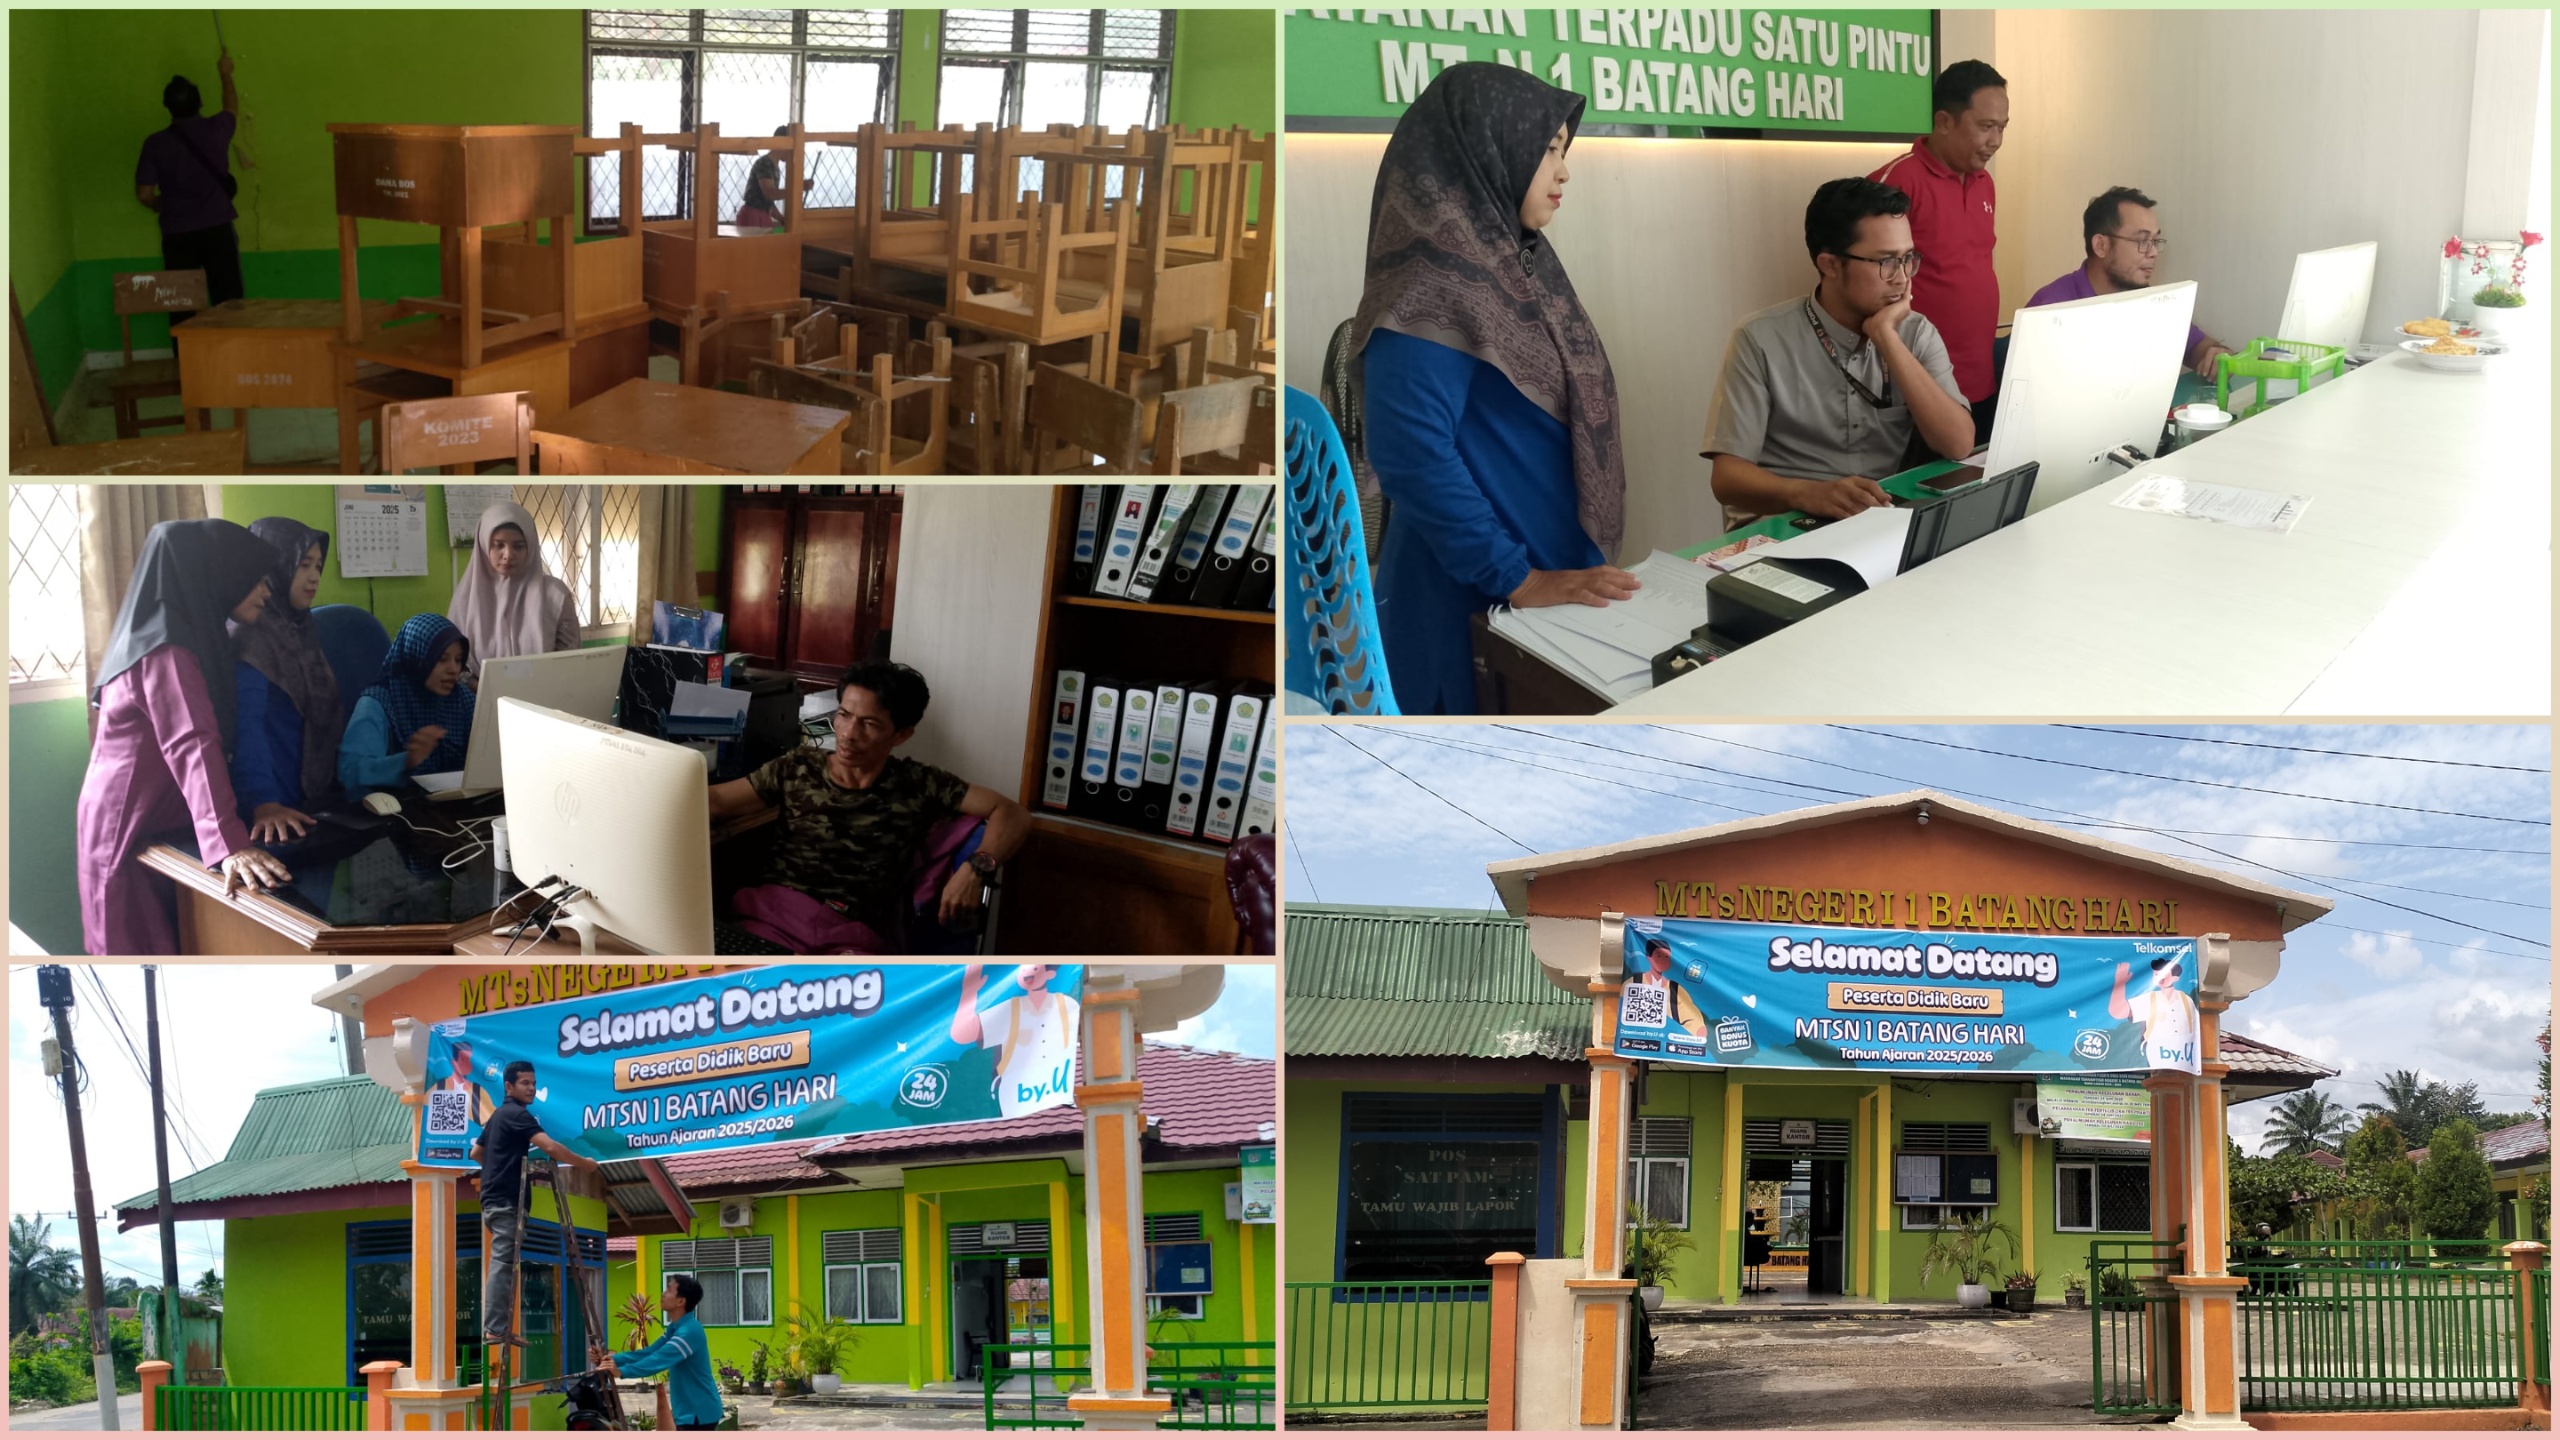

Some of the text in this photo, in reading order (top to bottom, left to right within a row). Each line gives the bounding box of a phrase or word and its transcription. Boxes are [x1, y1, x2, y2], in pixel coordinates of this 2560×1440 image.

[1751, 11, 1838, 67] SATU
[1847, 24, 1930, 76] PINTU
[1551, 52, 1571, 91] 1
[1591, 56, 1755, 117] BATANG
[1765, 70, 1844, 120] HARI
[399, 179, 416, 189] BOS
[423, 416, 493, 434] KOMITE
[437, 431, 480, 447] 2023
[381, 504, 399, 514] 2025
[1905, 891, 1919, 926] 1
[1928, 891, 2078, 929] BATANG
[2083, 897, 2179, 933] HARI
[2132, 942, 2193, 954] Telkomsel
[1769, 936, 2057, 983] Selamat Datang
[1842, 988, 1989, 1008] Peserta Didik Baru
[560, 971, 882, 1053] Selamat Datang
[1620, 1029, 1646, 1037] Download
[1720, 1025, 1745, 1034] BANYAK
[1721, 1032, 1747, 1040] BONUS
[1795, 1017, 2025, 1045] MTSN 1 BATANG HARI
[1722, 1039, 1748, 1048] KUOTA
[2083, 1034, 2102, 1048] 24
[1840, 1047, 1994, 1063] Tahun Ajaran 2025/2026
[2081, 1045, 2102, 1056] JAM
[630, 1043, 793, 1081] Peserta Didik Baru
[911, 1072, 937, 1091] 24
[584, 1074, 837, 1130] MTSN 1 BATANG HARI
[908, 1089, 936, 1102] JAM
[627, 1114, 795, 1149] Tahun Ajaran 2025/2026
[1429, 1149, 1467, 1162] POS
[1361, 1201, 1516, 1213] TAMU WAJIB LAPOR
[1771, 1256, 1800, 1266] BATANG
[362, 1315, 393, 1325] TAMU
